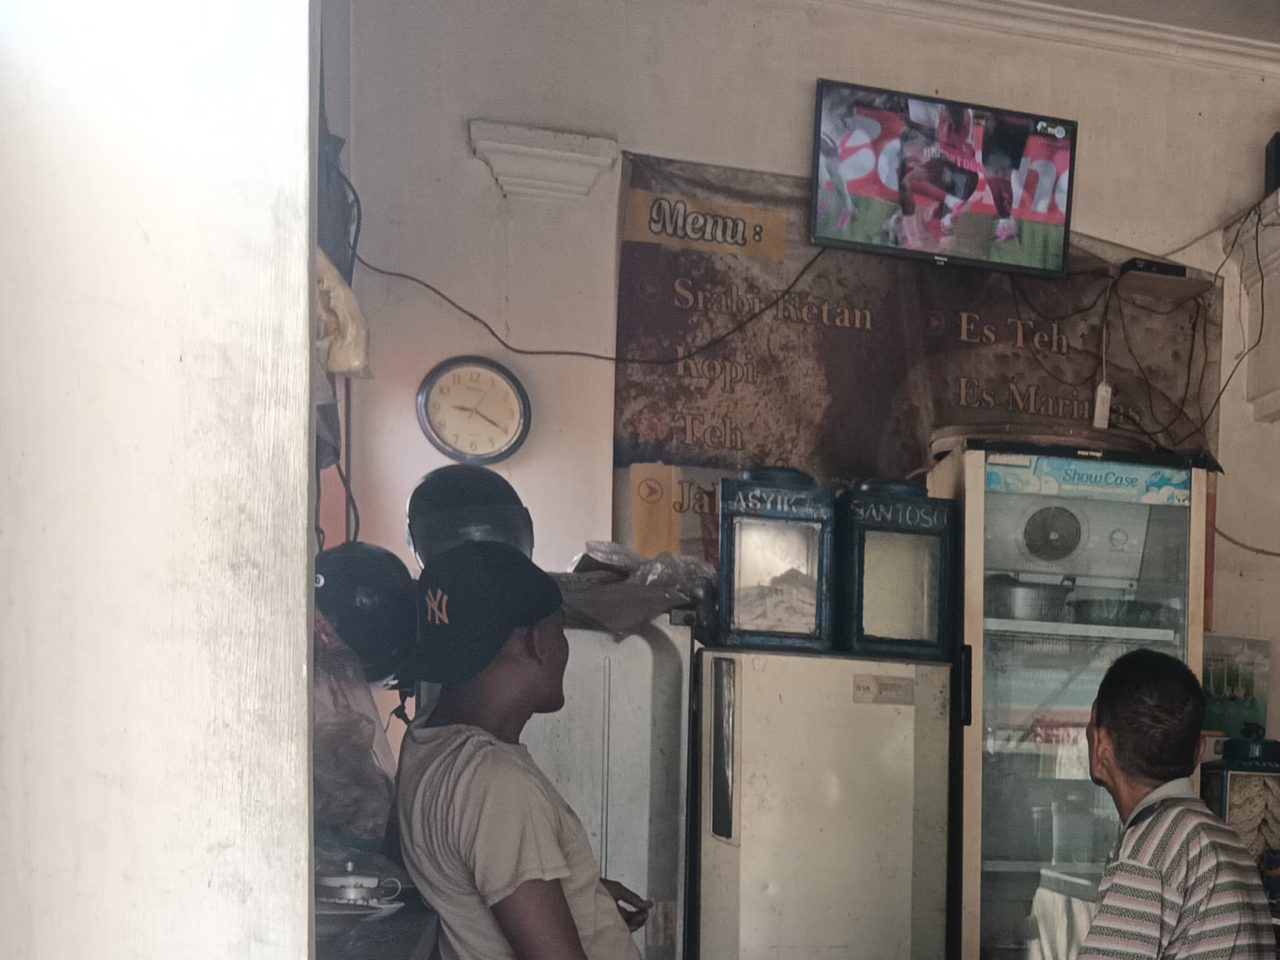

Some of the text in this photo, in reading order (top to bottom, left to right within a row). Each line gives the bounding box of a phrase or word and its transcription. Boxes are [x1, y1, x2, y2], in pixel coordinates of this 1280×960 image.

[775, 290, 873, 331] Ketan
[959, 312, 1069, 355] Es Teh
[959, 377, 1144, 425] Es Marias
[674, 410, 744, 450] Teh
